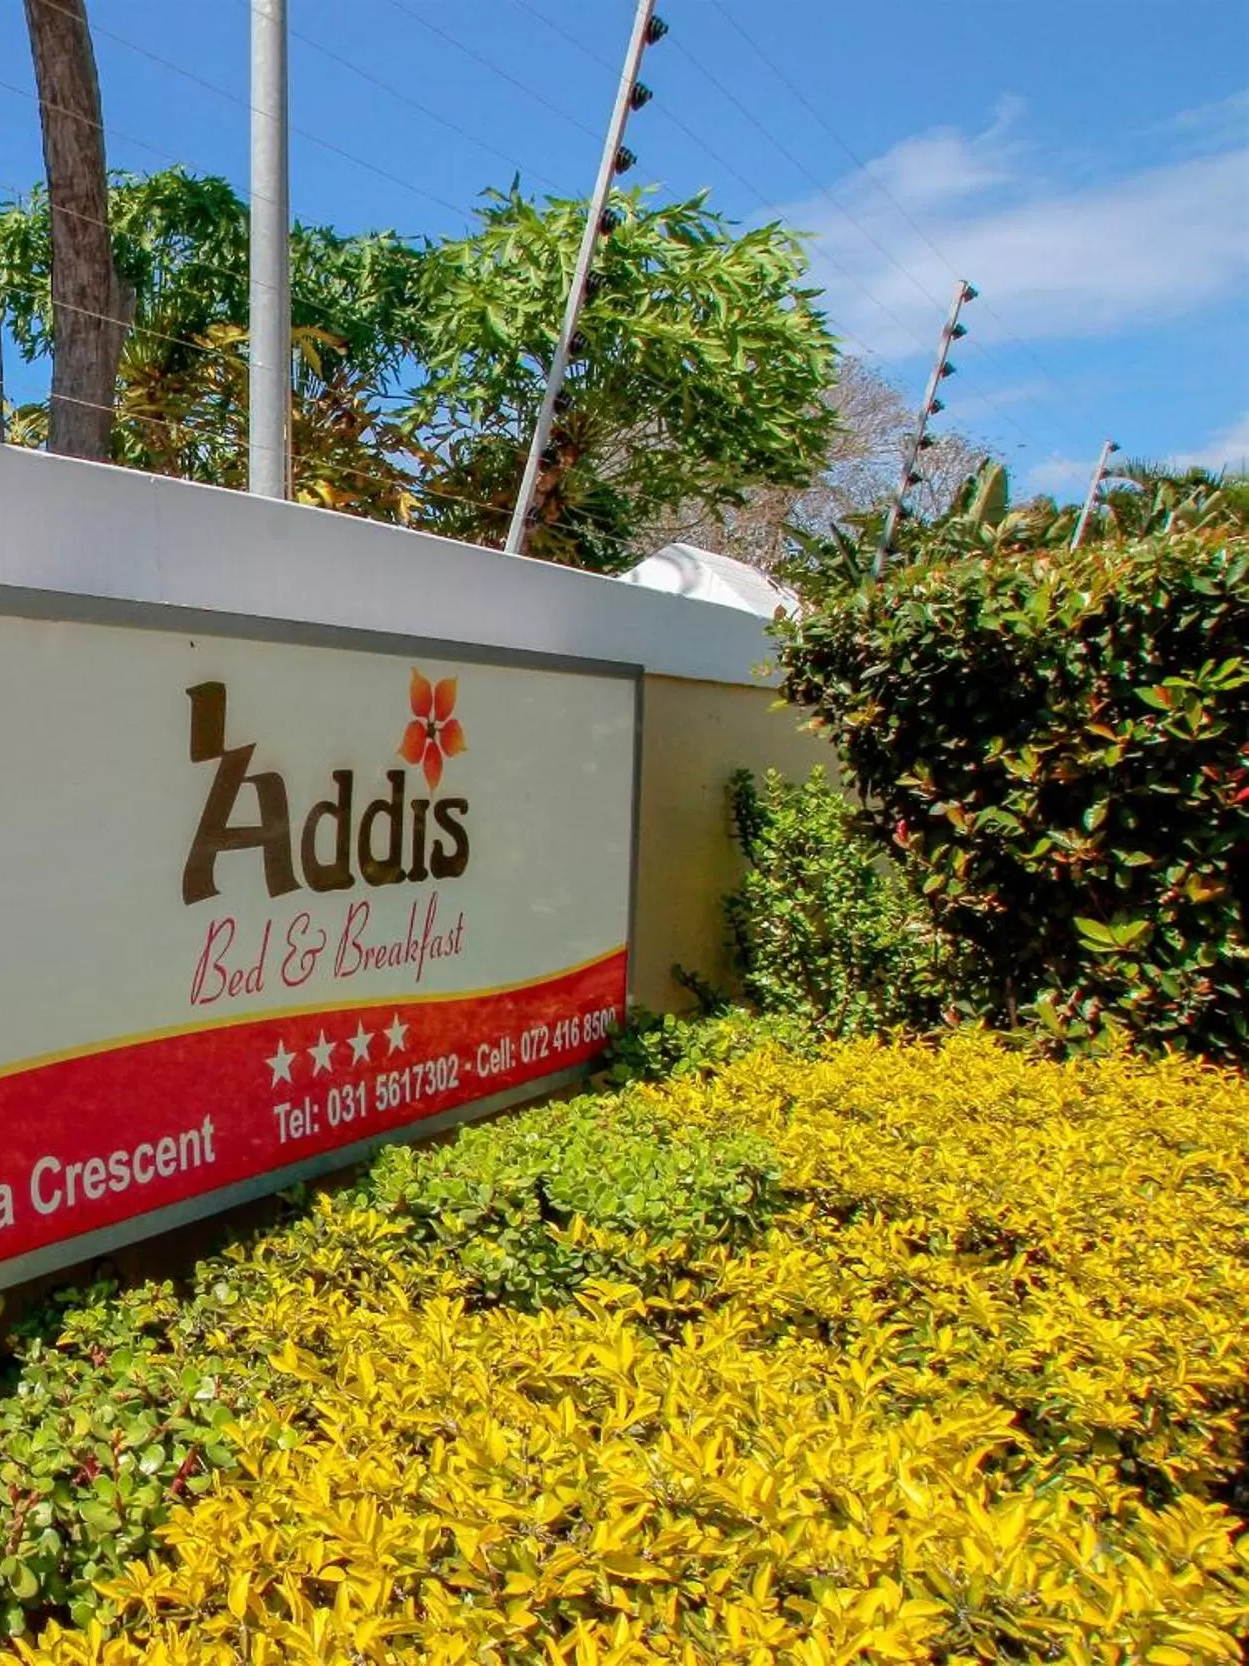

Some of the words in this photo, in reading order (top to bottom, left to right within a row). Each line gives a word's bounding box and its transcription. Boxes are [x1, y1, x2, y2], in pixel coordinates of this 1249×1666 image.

[190, 917, 272, 1006] Bed
[281, 912, 327, 987] &
[334, 891, 464, 983] Breakfast
[273, 1097, 320, 1144] Tel:
[326, 1082, 367, 1127] 031
[375, 1056, 459, 1112] 5617302
[476, 1036, 516, 1077] Cell:
[520, 1025, 550, 1062] 072
[552, 1016, 581, 1052] 416
[30, 1113, 217, 1215] Crescent
